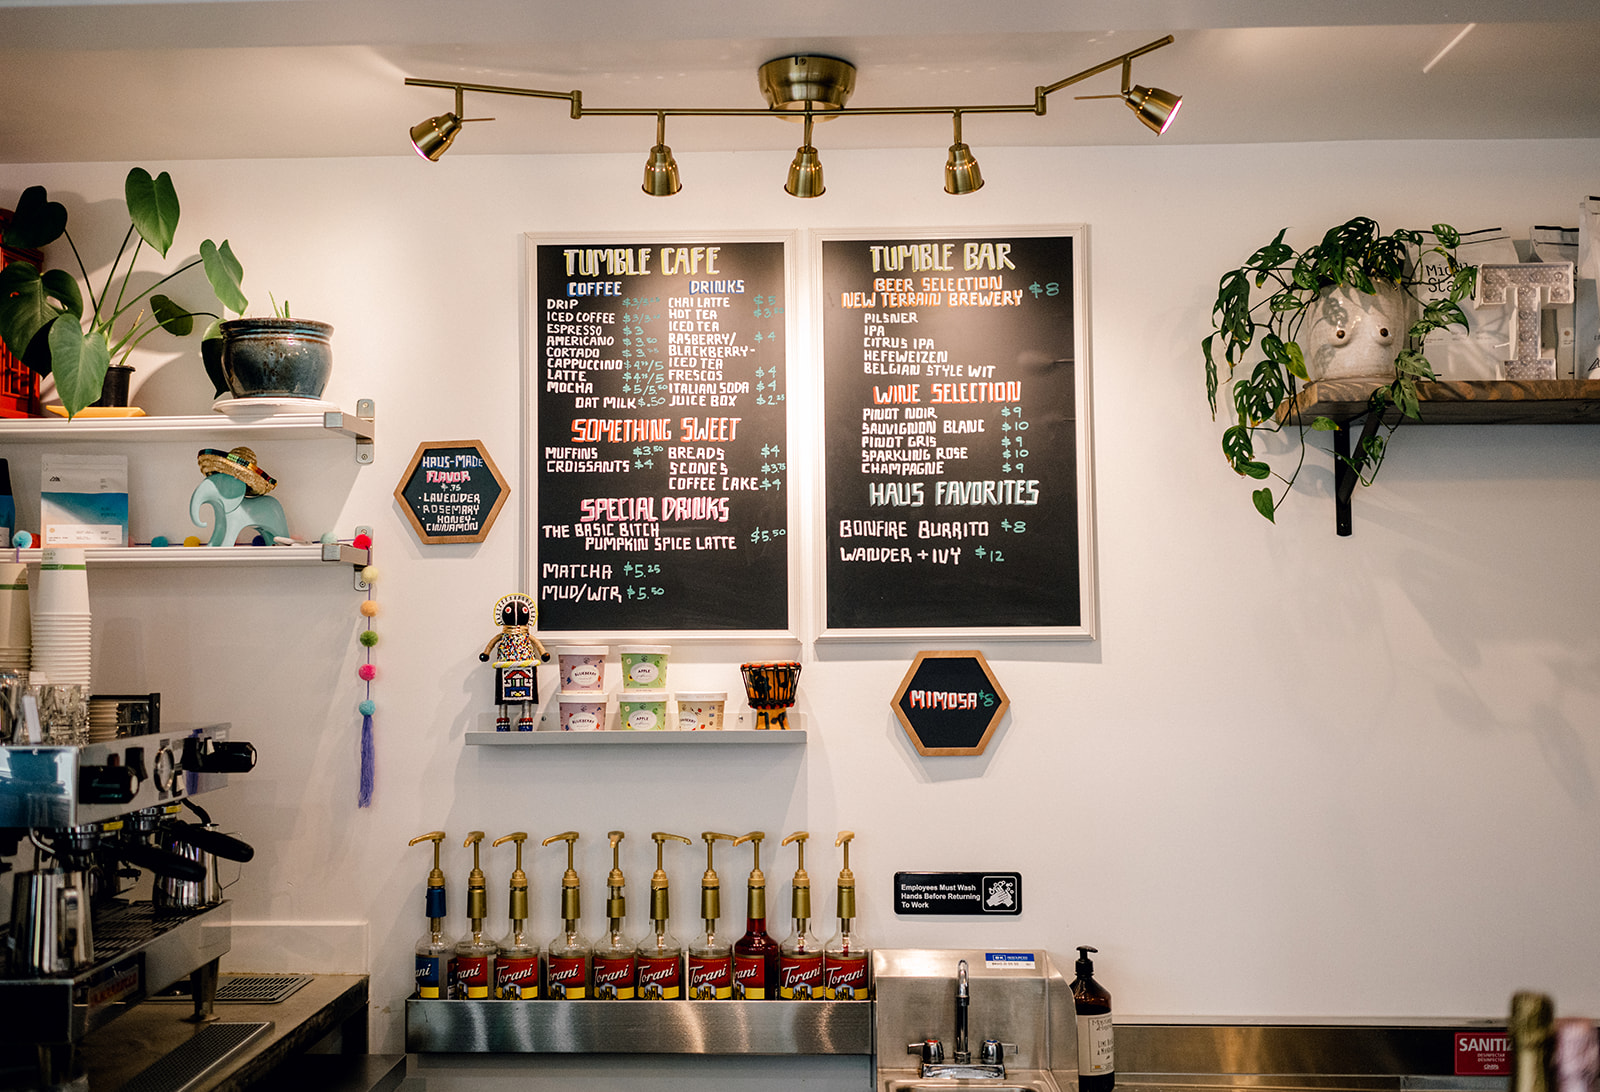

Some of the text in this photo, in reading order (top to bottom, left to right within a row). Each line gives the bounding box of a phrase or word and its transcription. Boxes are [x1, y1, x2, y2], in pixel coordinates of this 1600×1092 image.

[563, 247, 721, 276] TUMBLE CAFE
[870, 243, 1016, 272] TUMBLE BAR
[567, 282, 622, 297] COFFEE
[689, 280, 745, 295] DRINKS
[873, 275, 1003, 293] BEER SELECTION
[841, 281, 1059, 309] NEW TERRAIN BREWERY $8
[546, 299, 579, 310] DRIP
[668, 297, 695, 308] CHAI
[697, 297, 730, 308] LATTE
[546, 312, 574, 323] ICED
[575, 312, 616, 324] COFFEE
[668, 309, 692, 320] HOT
[696, 309, 718, 320] TEA
[864, 312, 918, 324] PILSNER
[546, 325, 644, 336] ESPRESSO $3
[668, 321, 720, 333] ICED TEA
[864, 325, 885, 337] IPA
[546, 336, 615, 347] AMERICANO
[668, 332, 737, 346] RASBERRY/
[864, 337, 935, 350] CITRUS IPA
[546, 347, 600, 359] CORTADO
[864, 350, 948, 364] HEFEWEIZEN
[546, 358, 623, 370] CAPPUCCINO
[668, 357, 724, 370] ICED TEA
[864, 362, 996, 378] BELGIAN STYLE WIT
[547, 370, 587, 382] LATTE
[668, 366, 777, 381] FRESCOS $4
[546, 382, 593, 394] MOCHA
[668, 380, 777, 394] ITALIAN SODA $4
[873, 381, 1021, 405] WINE SELECTION
[575, 397, 600, 409] OAT
[603, 397, 637, 409] MILK
[668, 395, 707, 407] JUICE
[710, 395, 738, 407] BOX
[863, 406, 1022, 421] PINOT NOIR $9
[571, 417, 742, 443] SOMETHING SWEET
[862, 419, 1030, 435] SAUVIGNON BLANC $10
[861, 435, 1023, 449] PINOT GRIS $9
[545, 447, 598, 460] MUFFINS
[668, 443, 781, 461] BREADS $4
[861, 447, 1029, 462] SPARKLING ROSE $10
[422, 455, 483, 469] HAUS-MADE
[546, 459, 654, 473] CROISSANTS $4
[669, 462, 729, 475] SCONES
[861, 461, 1024, 476] CHAMPAGNE $9
[426, 470, 471, 483] FLAVOR
[668, 477, 781, 491] COFFEE CAKE $4
[423, 493, 480, 504] LAVENDER
[869, 479, 1040, 507] HAUS FAVORITES
[423, 504, 480, 515] ROSEMARY
[580, 496, 729, 522] SPECIAL DRINKS
[426, 522, 478, 532] CINNAMON
[542, 523, 660, 538] THE BASIC BITCH
[839, 518, 1026, 540] BONFIRE BURRITO $8
[585, 527, 786, 551] PUMPKIN SPICE LATTE $5.50
[840, 545, 1005, 565] WANDER + IVY $12
[542, 563, 613, 580] MATCHA
[542, 583, 665, 603] MUD/WTR $5.50
[909, 689, 995, 710] MIMOSA $8
[901, 884, 938, 893] Employees
[947, 893, 981, 901] Returning
[496, 963, 534, 987] Torani
[594, 964, 629, 987] Torani
[638, 964, 674, 987] Torani
[690, 964, 727, 987] Torani
[782, 962, 821, 989] Torani
[826, 965, 865, 989] Torani
